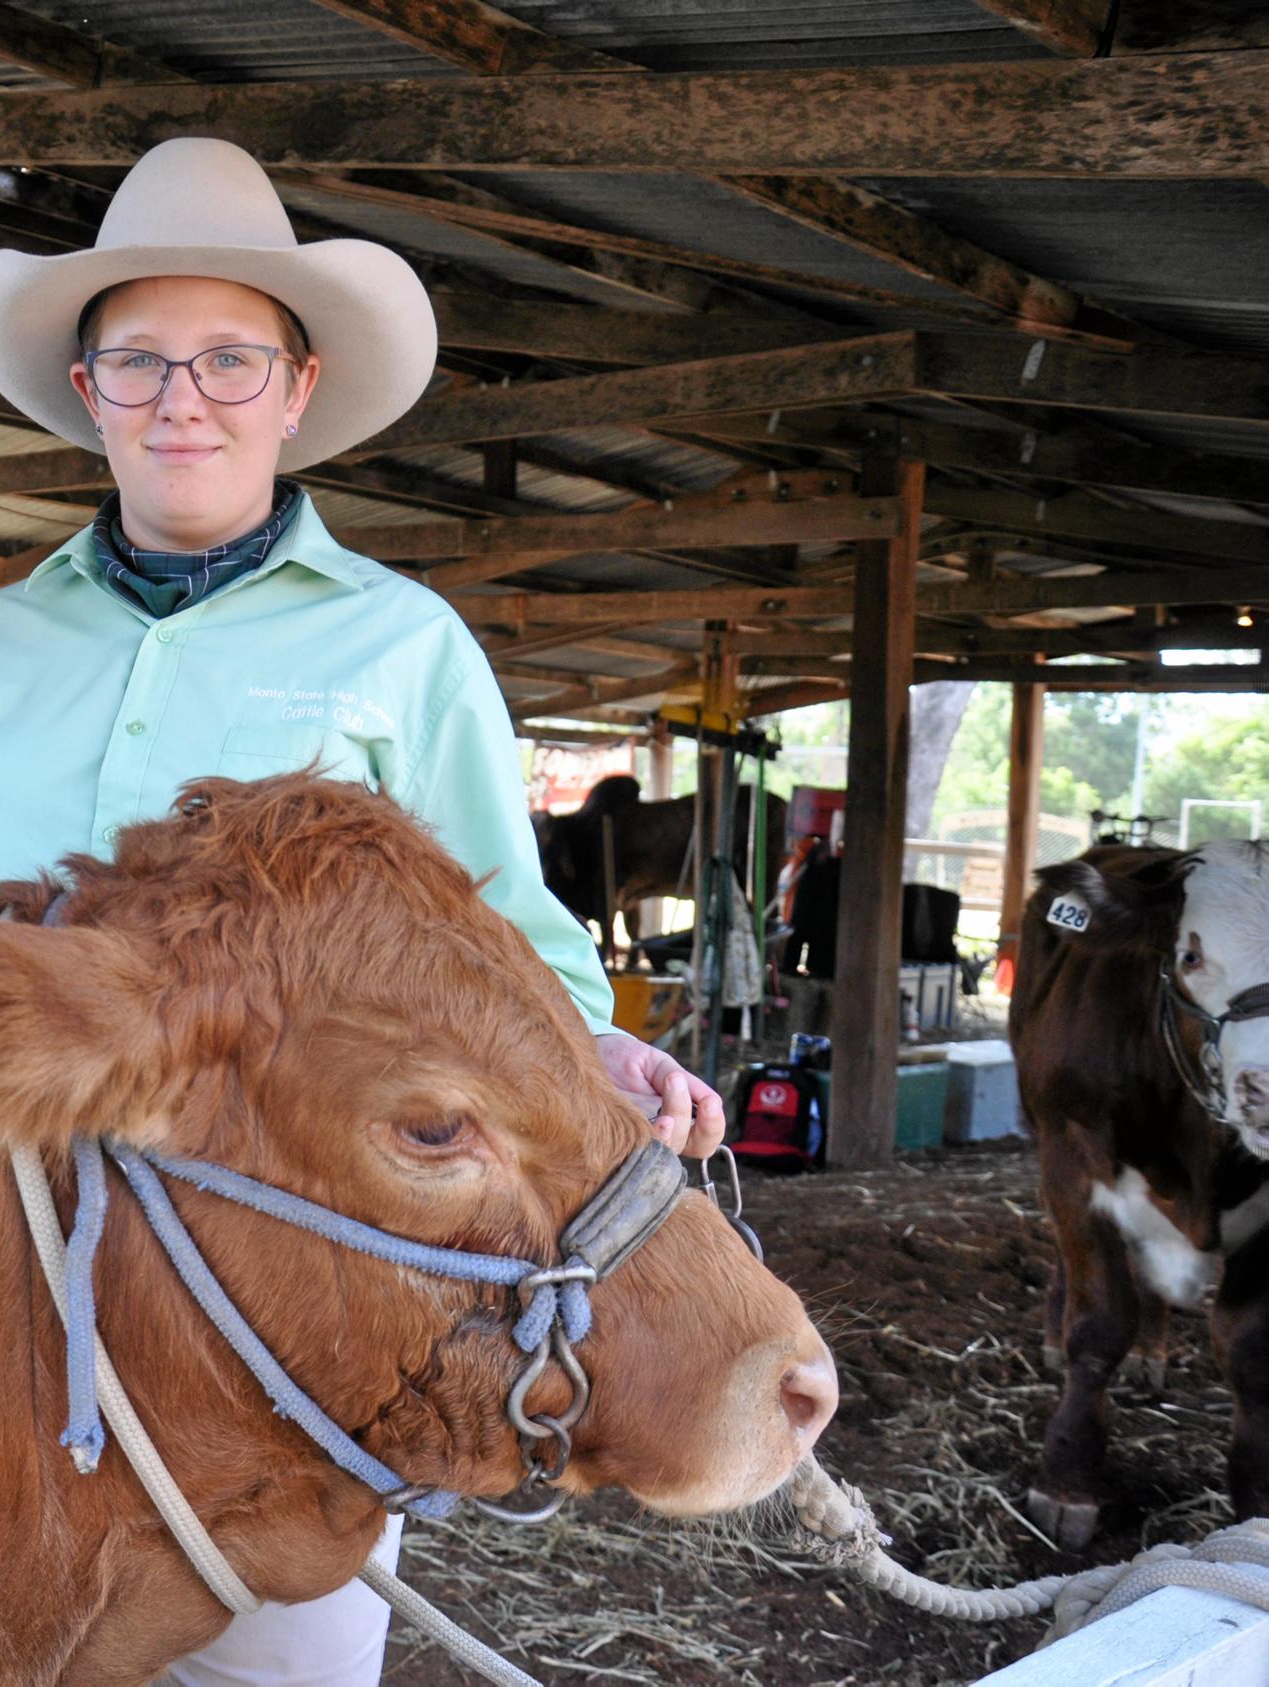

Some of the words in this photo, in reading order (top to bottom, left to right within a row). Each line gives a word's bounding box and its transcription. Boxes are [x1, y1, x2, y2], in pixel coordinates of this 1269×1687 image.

[247, 686, 285, 699] Monto
[292, 689, 325, 701] State
[331, 688, 359, 705] High
[282, 704, 325, 721] Cattle
[332, 706, 364, 732] Club
[1053, 903, 1088, 928] 428
